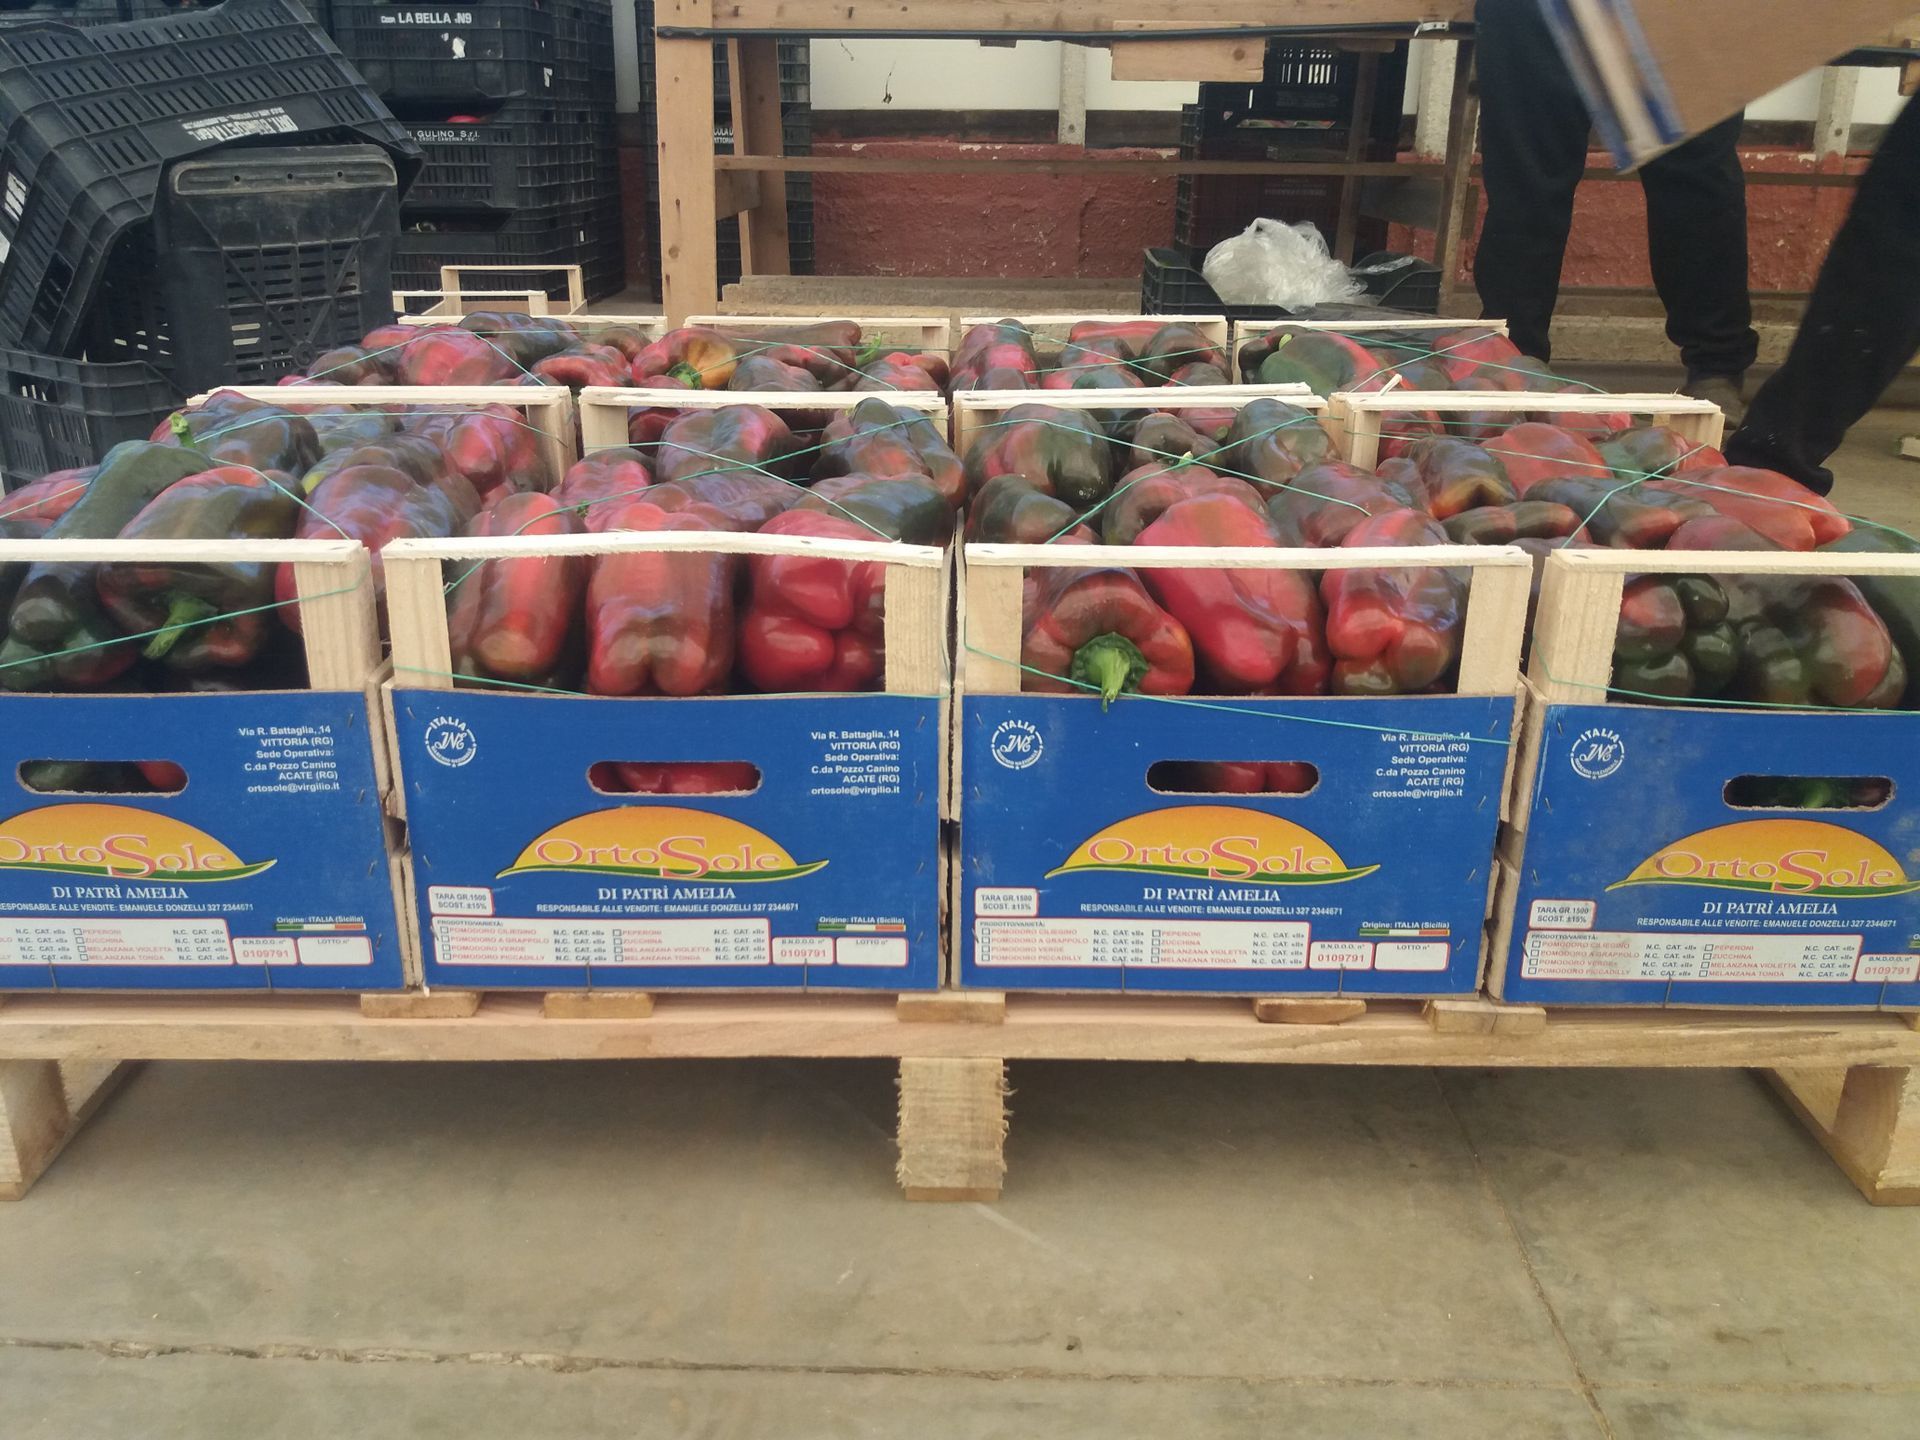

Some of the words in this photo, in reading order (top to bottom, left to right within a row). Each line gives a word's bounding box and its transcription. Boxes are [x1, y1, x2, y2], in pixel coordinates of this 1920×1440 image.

[398, 12, 414, 24] LA
[415, 12, 452, 24] BELLA
[416, 130, 455, 138] GULINO
[430, 716, 466, 731] ITALIA
[998, 720, 1036, 734] ITALIA
[239, 728, 254, 736] Via
[270, 726, 317, 736] Battaglia,
[811, 732, 826, 740] Via
[842, 731, 886, 740] Battaglia,
[1580, 728, 1620, 743] ITALIA
[261, 738, 309, 747] VITTORIA
[311, 737, 334, 746] (RG)
[1382, 734, 1396, 742] Via
[1399, 734, 1408, 742] R.
[831, 742, 877, 750] VITTORIA
[879, 741, 900, 750] (RG)
[1400, 745, 1445, 753] VITTORIA
[1448, 744, 1470, 753] (RG)
[284, 750, 334, 759] Operativa:
[825, 754, 848, 762] Sede
[851, 753, 900, 762] Operativa:
[1392, 756, 1415, 764] Sede
[1418, 756, 1467, 765] Operativa:
[245, 763, 267, 771] C.da
[269, 762, 299, 770] Pozzo
[812, 766, 833, 774] C.da
[867, 765, 900, 773] Canino
[279, 772, 313, 780] ACATE
[316, 771, 338, 780] (RG)
[1401, 768, 1429, 776] Pozzo
[843, 775, 875, 783] ACATE
[879, 775, 900, 784] (RG)
[1406, 778, 1440, 786] ACATE
[1442, 777, 1464, 786] (RG)
[248, 783, 340, 793] ortosole@virgilio.it
[811, 786, 900, 796] ortosole@virgilio.it
[1373, 789, 1463, 799] ortosole@virgilio.it
[53, 887, 72, 898] DI
[76, 885, 121, 899] PATRÌ
[126, 887, 188, 899] AMELIA
[599, 888, 617, 900] DI
[623, 886, 668, 900] PATRÌ
[673, 888, 736, 900] AMELIA
[1143, 888, 1162, 900] DI
[1168, 886, 1214, 901] PATRÌ
[1218, 889, 1280, 902] AMELIA
[59, 903, 79, 912] ALLE
[81, 903, 117, 912] VENDITE:
[120, 903, 164, 912] EMANUELE
[165, 904, 206, 912] DONZELLI
[208, 904, 220, 912] 327
[537, 904, 600, 913] RESPONSABILE
[602, 904, 623, 913] ALLE
[625, 904, 663, 913] VENDITE:
[664, 904, 709, 912] EMANUELE
[711, 904, 750, 912] DONZELLI
[752, 903, 766, 912] 327
[1080, 903, 1143, 912] RESPONSABILE
[1144, 904, 1166, 913] ALLE
[1168, 905, 1205, 914] VENDITE:
[1207, 905, 1252, 914] EMANUELE
[1254, 906, 1294, 915] DONZELLI
[1296, 906, 1310, 915] 327
[1703, 902, 1722, 914] DI
[1727, 900, 1773, 915] PATRÌ
[1777, 903, 1838, 915] AMELIA
[1637, 918, 1700, 927] RESPONSABILE
[1701, 918, 1722, 927] ALLE
[1725, 918, 1762, 928] VENDITE:
[1763, 919, 1808, 928] EMANUELE
[1809, 919, 1850, 928] DONZELLI
[1850, 919, 1865, 928] 327
[243, 950, 289, 958] 0109791
[781, 949, 826, 957] 0109791
[1318, 954, 1365, 962] 0109791
[1864, 966, 1911, 975] 0109791
